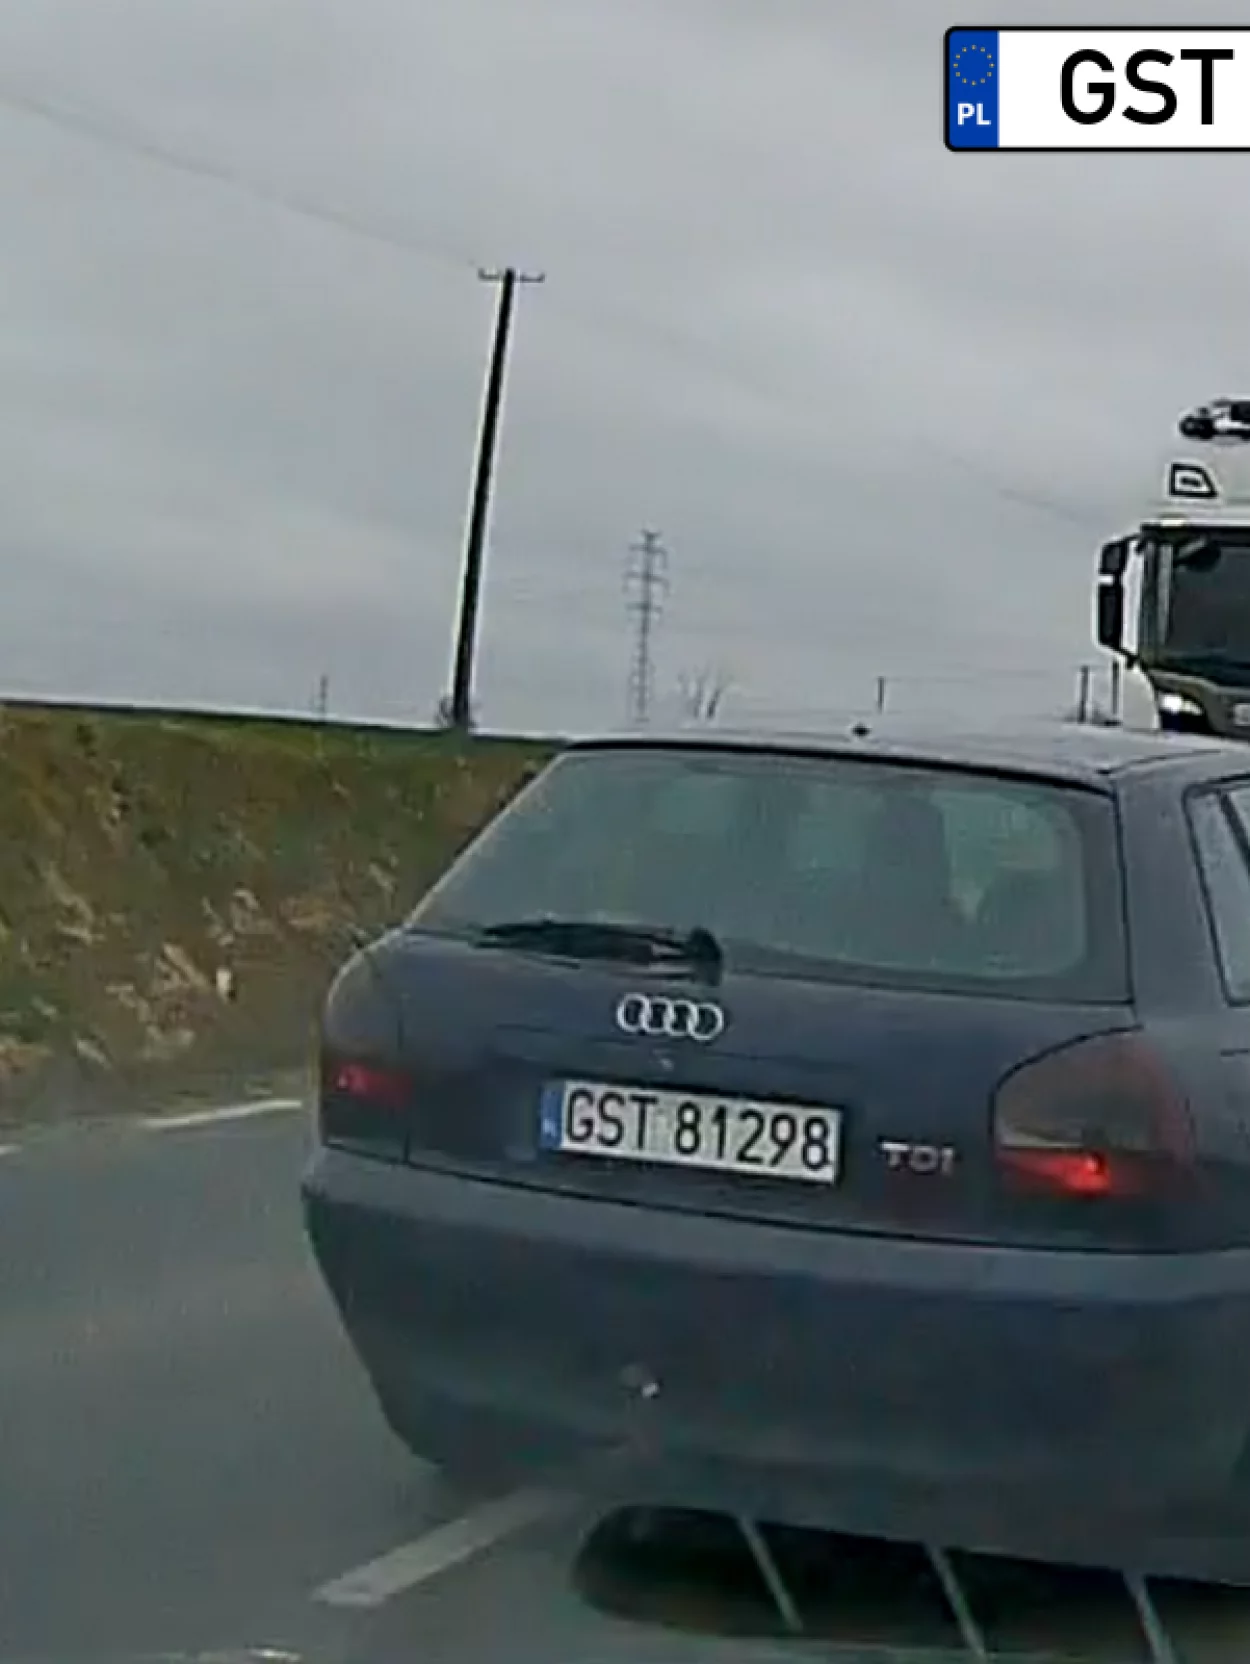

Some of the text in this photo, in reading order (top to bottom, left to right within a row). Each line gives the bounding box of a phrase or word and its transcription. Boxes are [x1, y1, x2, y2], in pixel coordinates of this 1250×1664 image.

[566, 1087, 832, 1171] GST 81298
[881, 1142, 955, 1176] TDI
